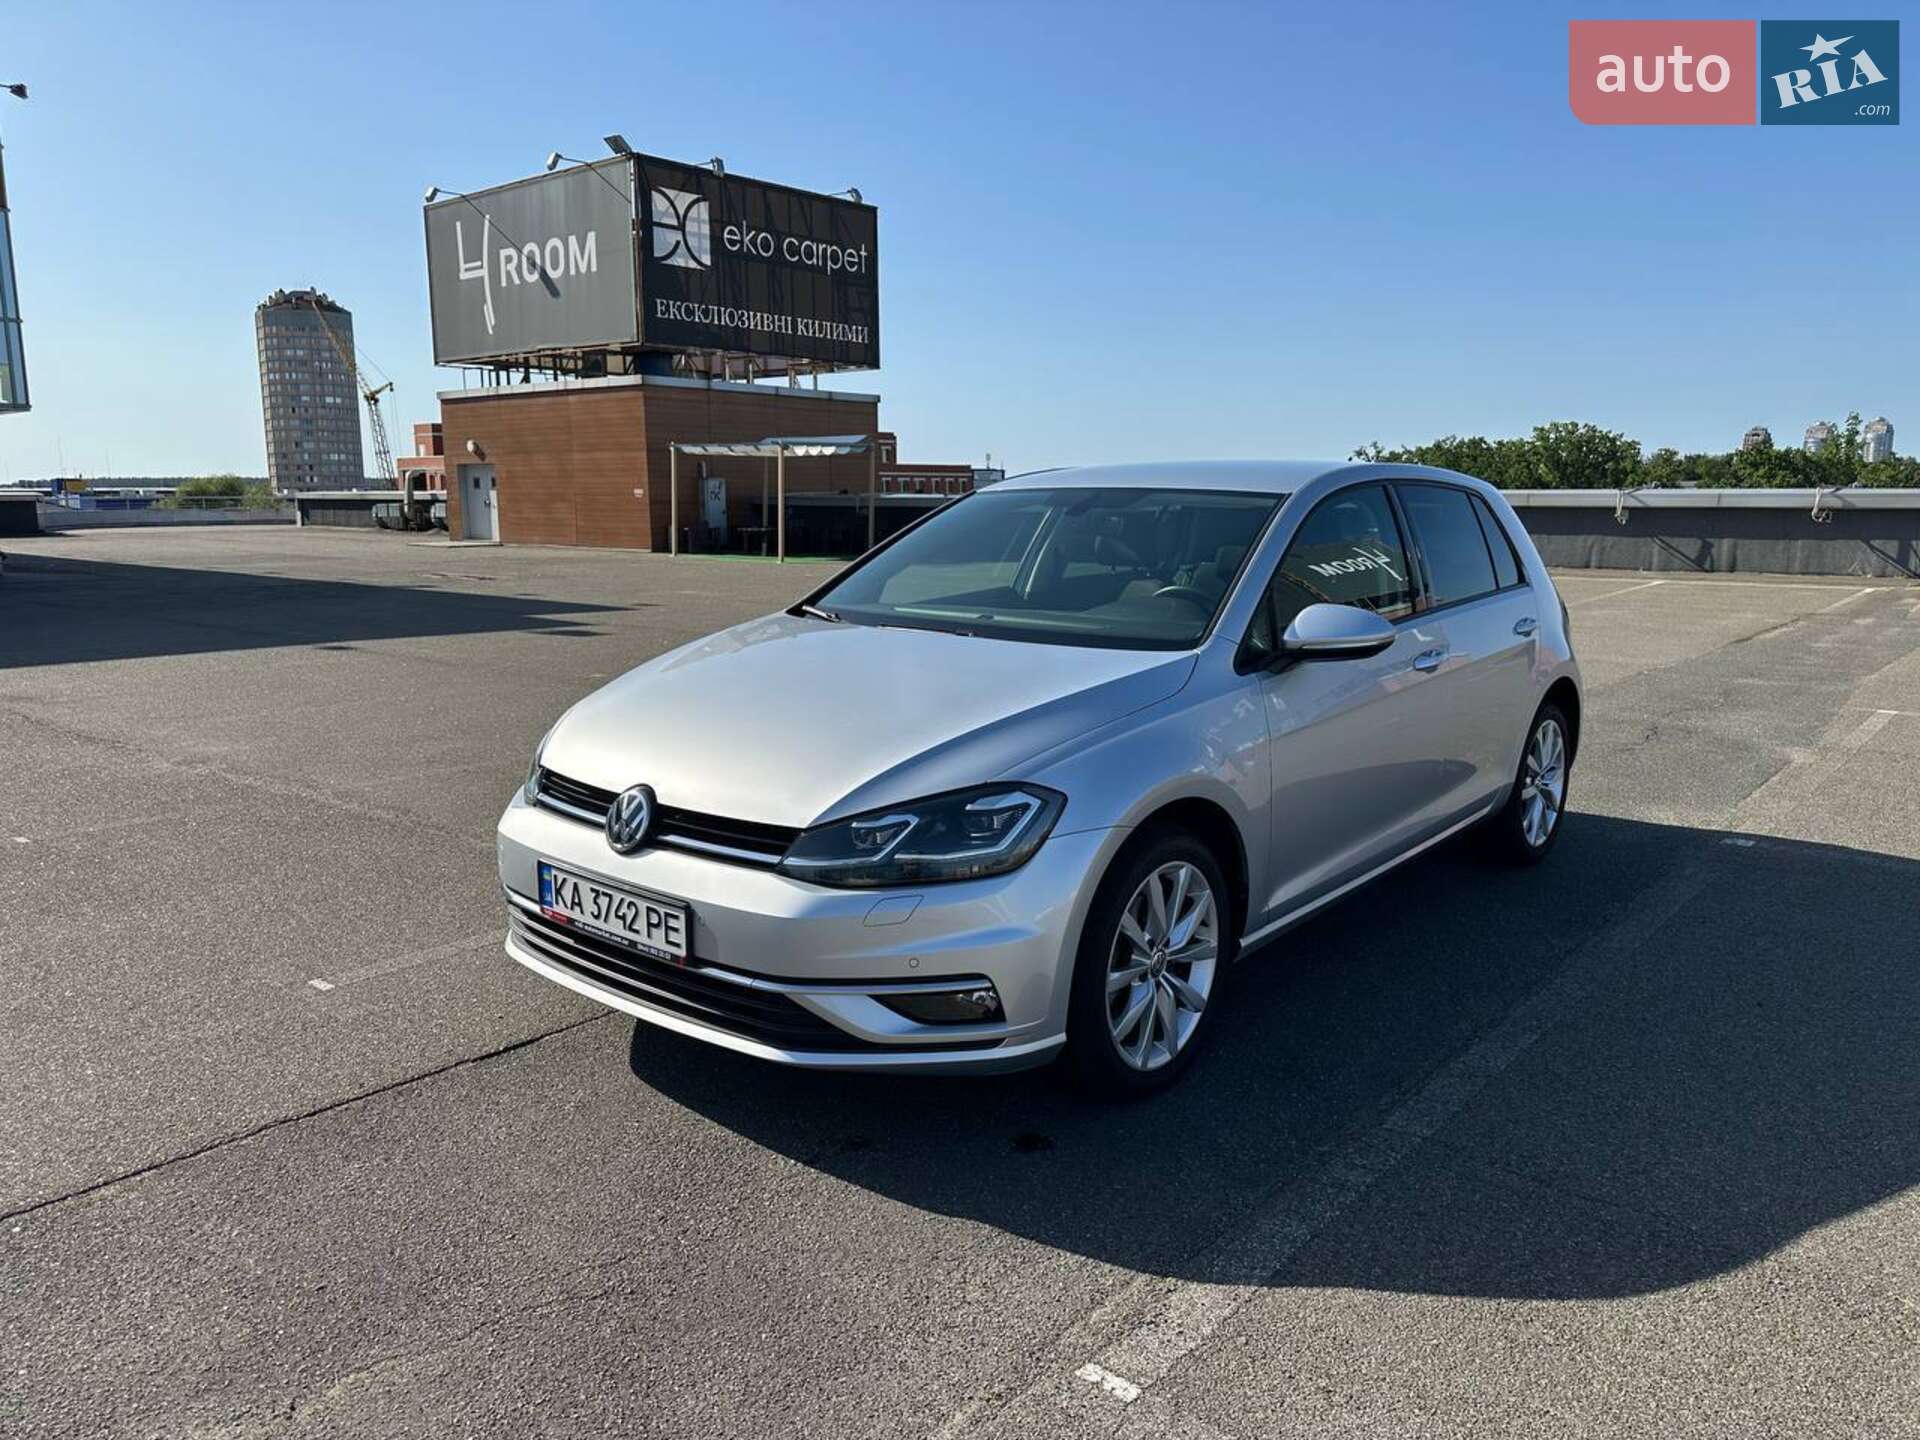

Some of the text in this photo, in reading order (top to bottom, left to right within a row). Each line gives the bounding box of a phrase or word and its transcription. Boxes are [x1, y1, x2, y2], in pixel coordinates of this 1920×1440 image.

[723, 220, 868, 275] eko carpet
[655, 298, 869, 344] ЕКСКЛЮЗИВНІ КИЛИМИ
[554, 875, 584, 914] KA
[590, 887, 640, 934] 3742
[646, 905, 682, 949] PE
